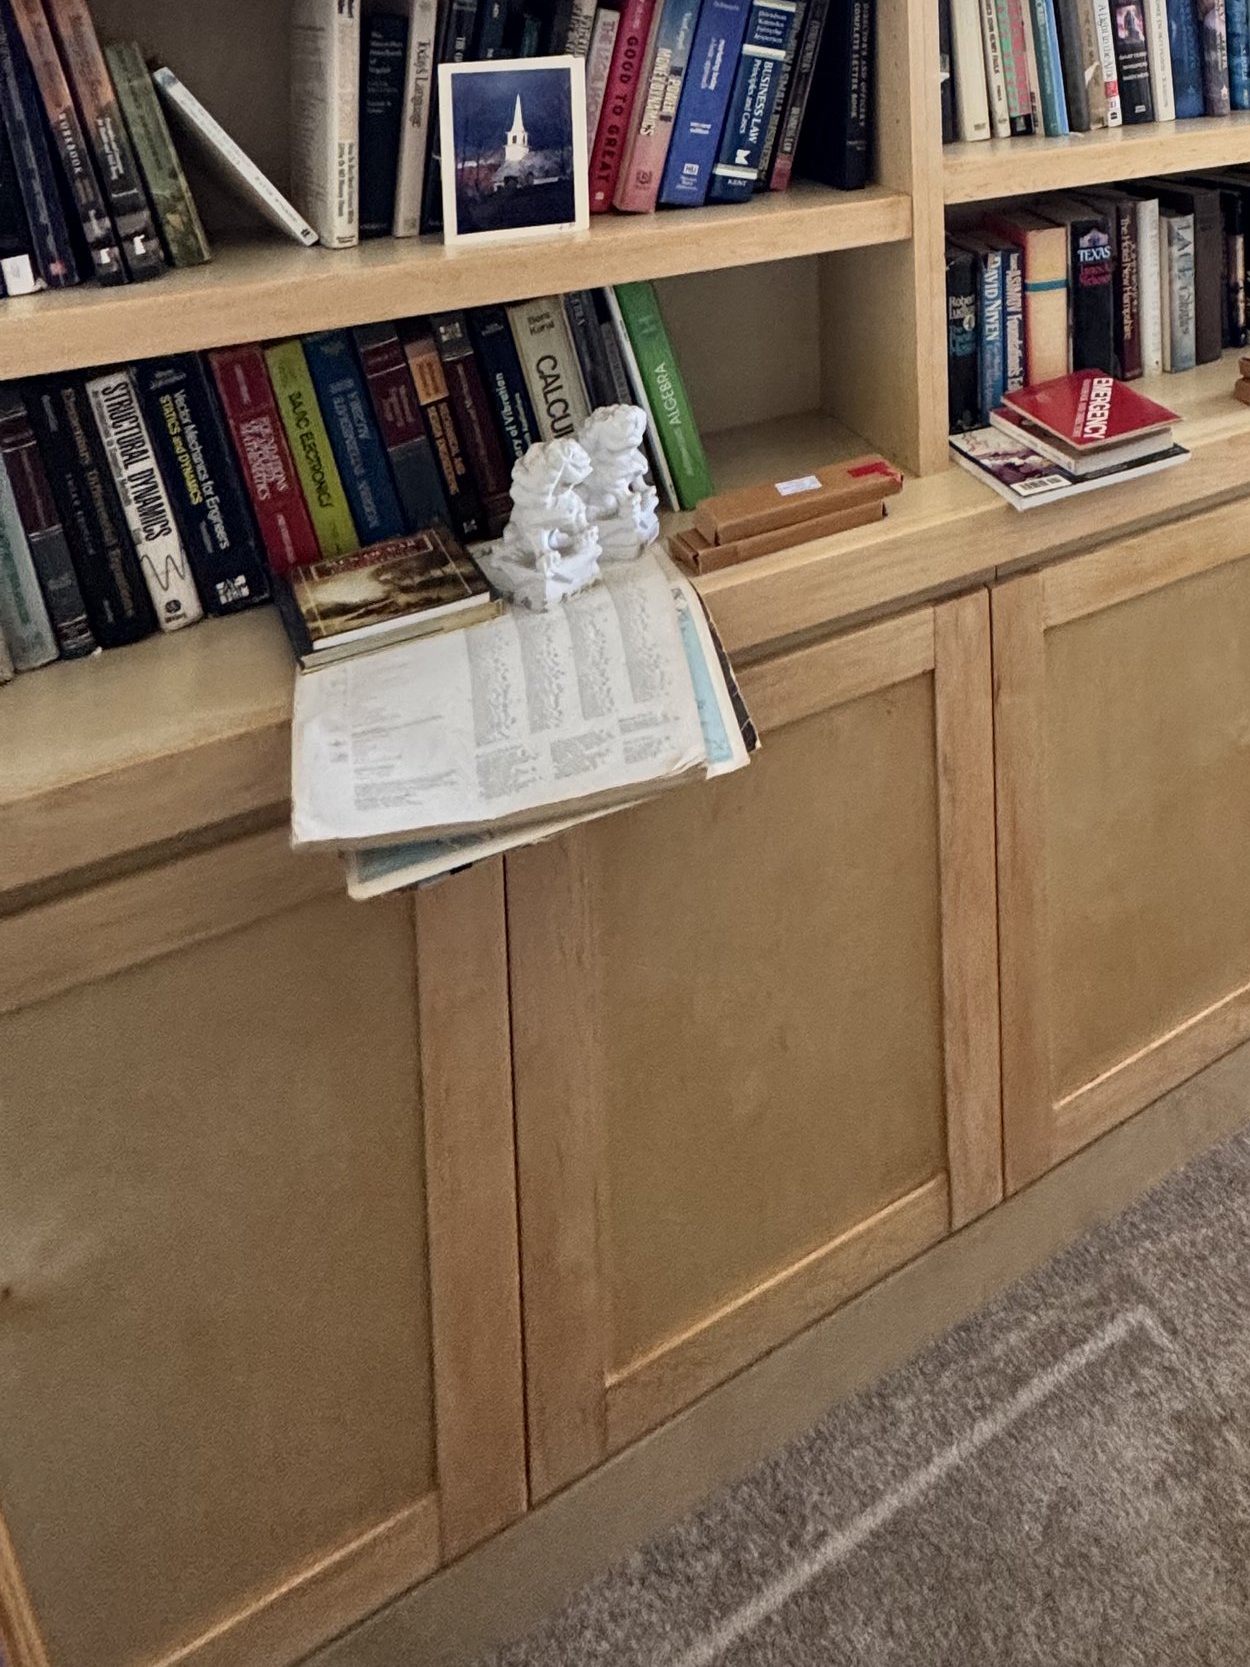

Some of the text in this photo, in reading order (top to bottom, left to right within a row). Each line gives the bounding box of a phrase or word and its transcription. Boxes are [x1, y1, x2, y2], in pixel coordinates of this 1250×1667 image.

[1098, 12, 1109, 34] Light
[1103, 45, 1112, 59] the
[409, 39, 431, 129] Today's Language
[595, 36, 638, 183] GOOD TO GREAT
[640, 47, 672, 136] MONEY DYNAMICS
[664, 78, 682, 113] POWER
[739, 59, 762, 134] Principles and Cases
[749, 61, 774, 144] BUSINESS LAW
[727, 179, 748, 187] KENT
[1077, 245, 1112, 262] TEXAS
[1120, 215, 1134, 340] The Hotel New Hampshire
[984, 256, 1002, 342] DAVID NIVEN
[1005, 269, 1022, 312] ASIMOV
[159, 394, 181, 436] STATICS
[496, 372, 518, 421] Vibration
[655, 362, 682, 425] ALGEBRA
[1083, 377, 1114, 439] EMERGENCY
[102, 382, 172, 542] STRUCTURAL DYNAMICS
[172, 437, 186, 454] and
[173, 389, 230, 549] Vector Mechanics for Engineers
[300, 431, 335, 509] ELECTRONICS
[178, 453, 203, 506] DYNAMICS
